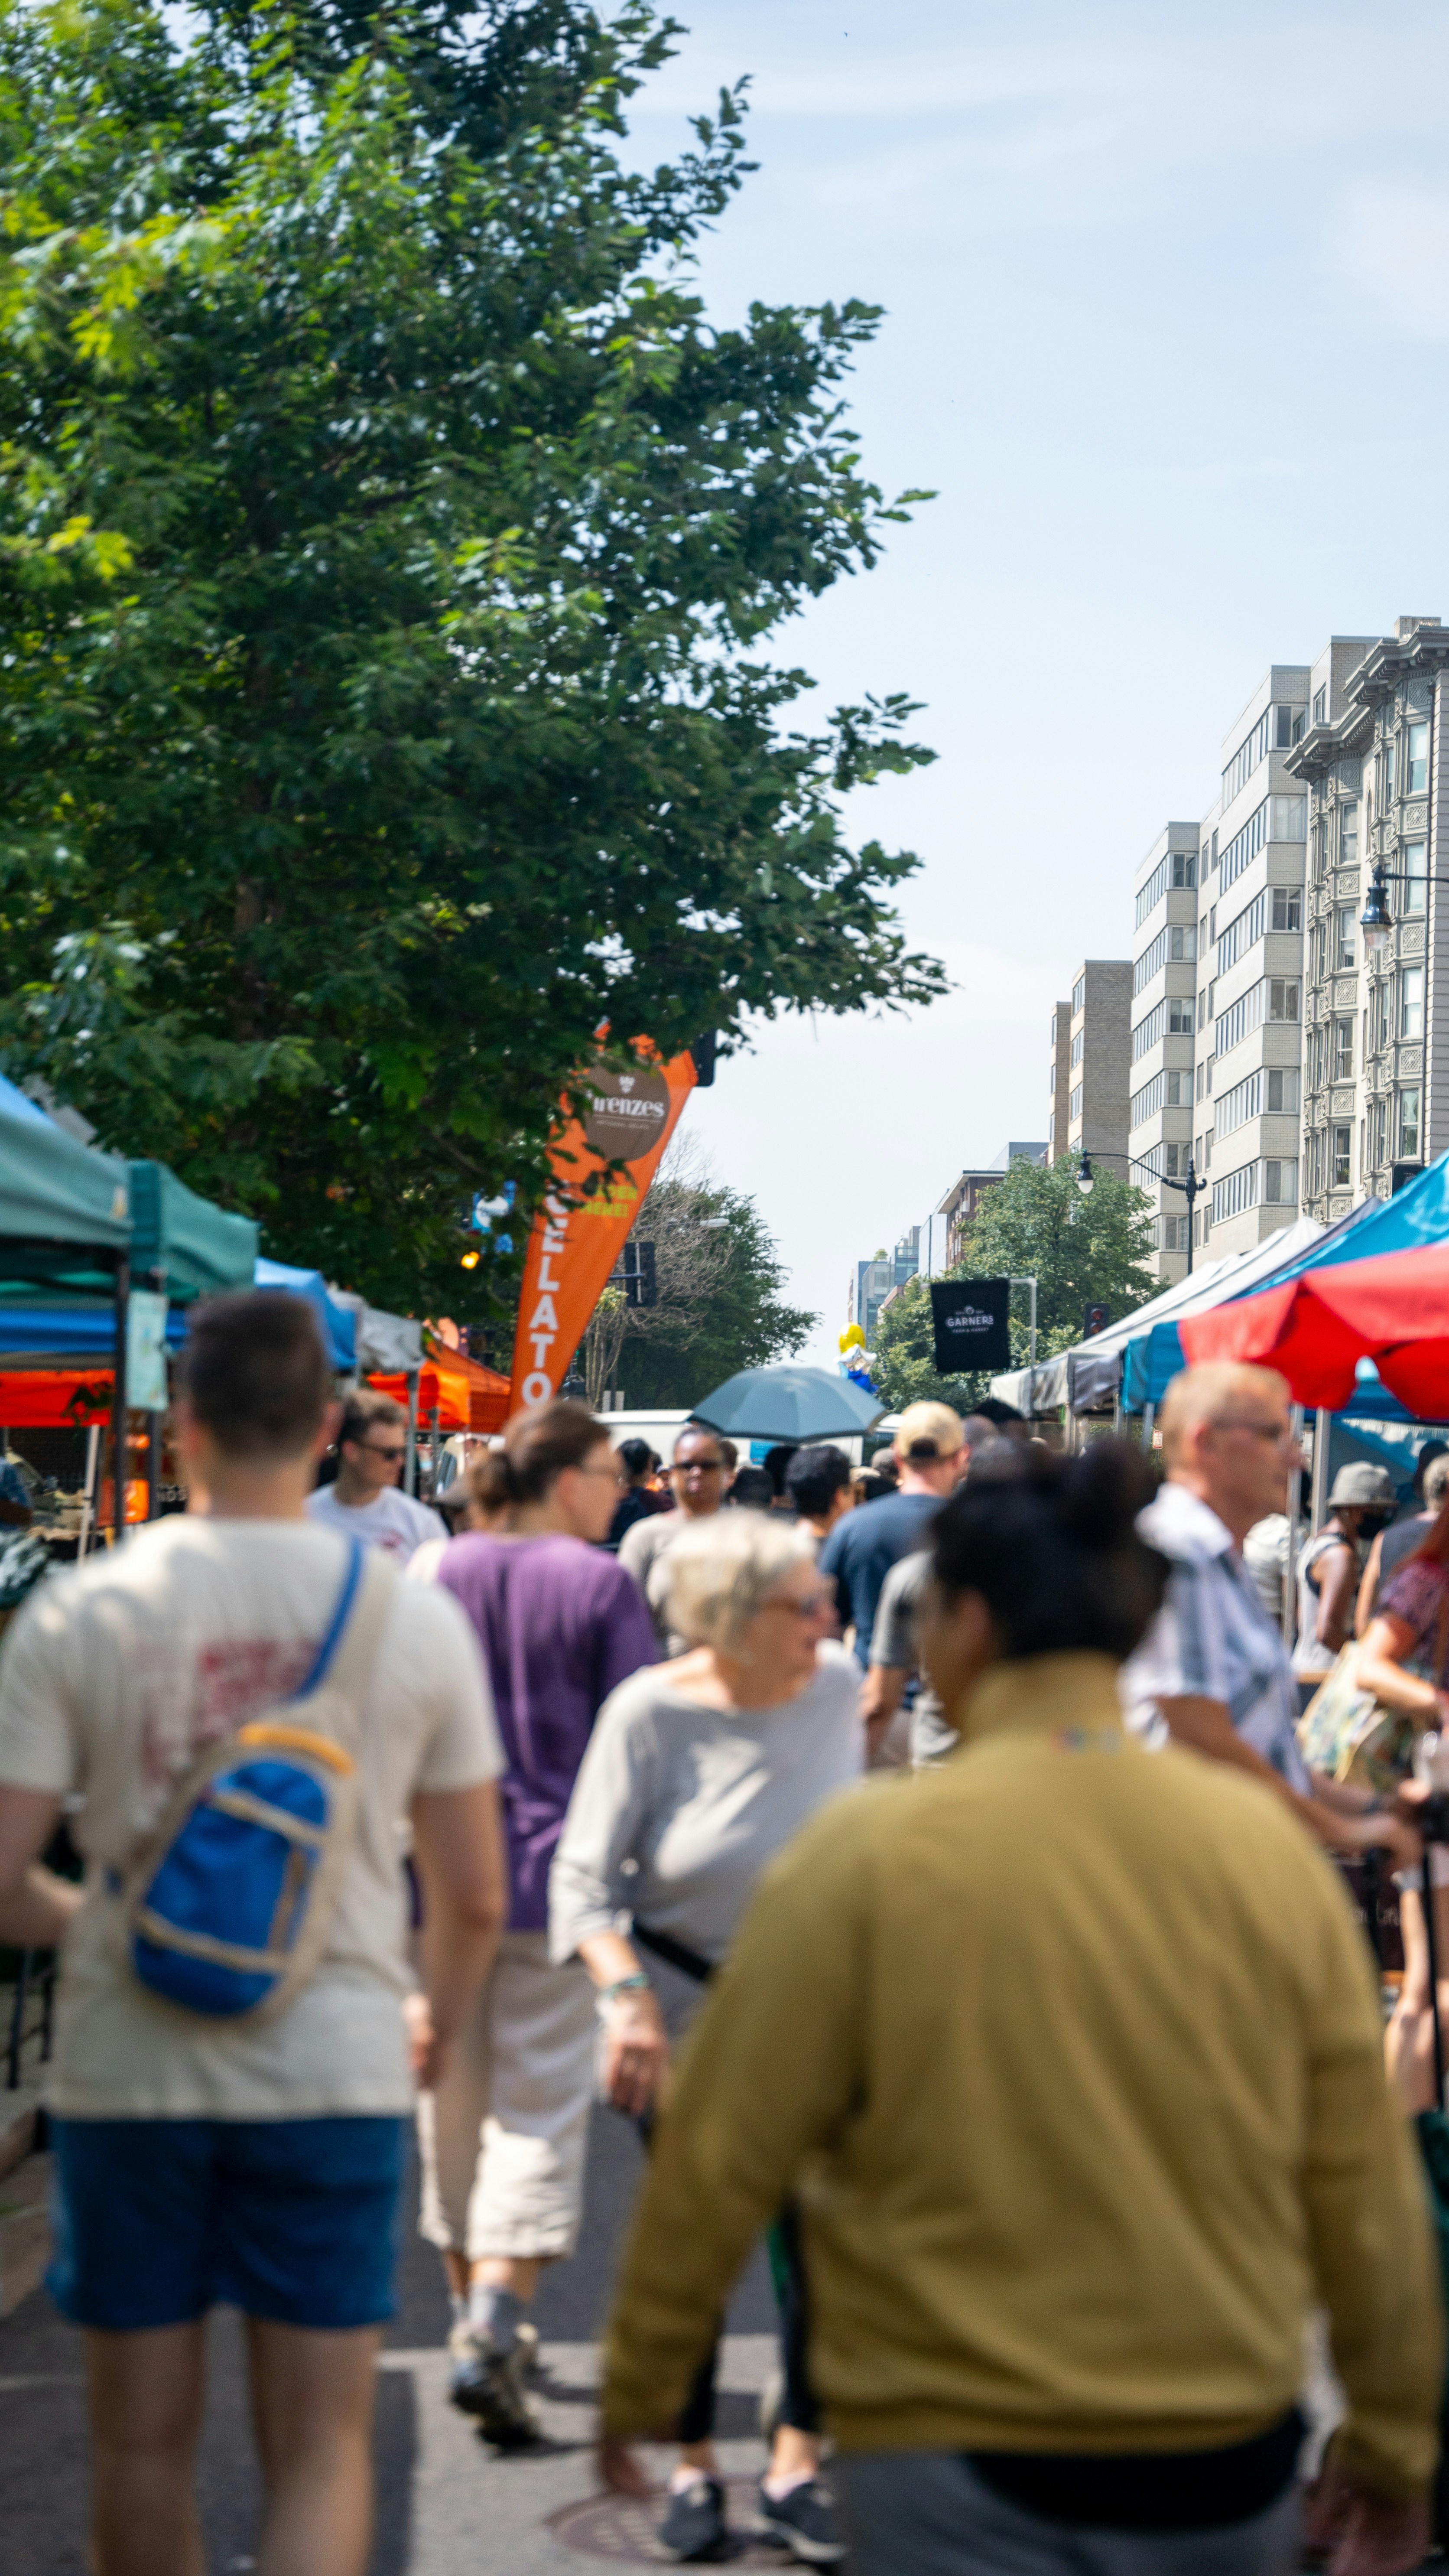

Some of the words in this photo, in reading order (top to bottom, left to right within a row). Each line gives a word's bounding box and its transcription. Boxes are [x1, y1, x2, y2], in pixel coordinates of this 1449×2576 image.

[586, 1089, 665, 1117] irenzes
[593, 1184, 638, 1200] DER
[946, 1316, 994, 1327] GARNERS
